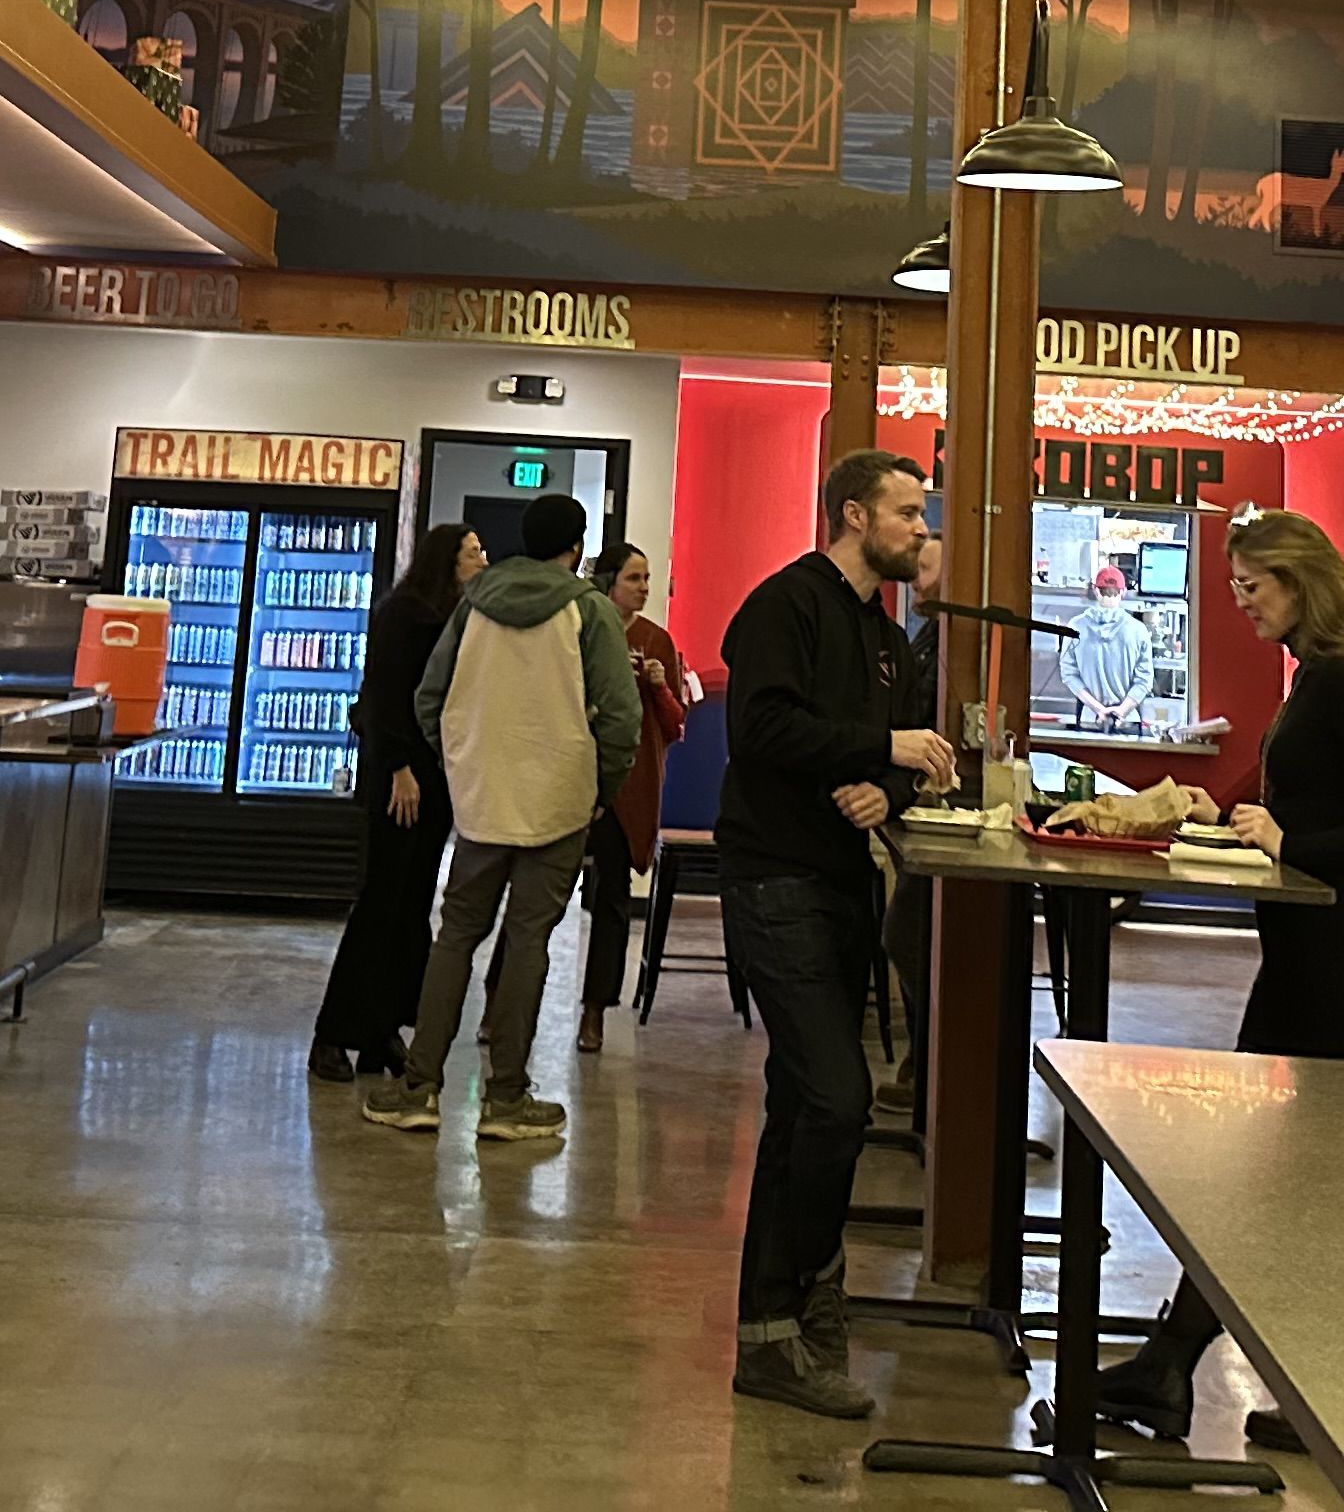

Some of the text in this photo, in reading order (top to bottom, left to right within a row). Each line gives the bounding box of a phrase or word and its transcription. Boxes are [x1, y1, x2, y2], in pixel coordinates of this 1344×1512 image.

[27, 265, 239, 323] BEER TO GO
[407, 288, 631, 342] RESTROOMS
[1096, 321, 1183, 373] PICK
[1192, 328, 1240, 377] UP
[126, 432, 393, 487] TRAIL MAGIC
[514, 462, 544, 488] EXIT
[1035, 438, 1224, 507] OBOP
